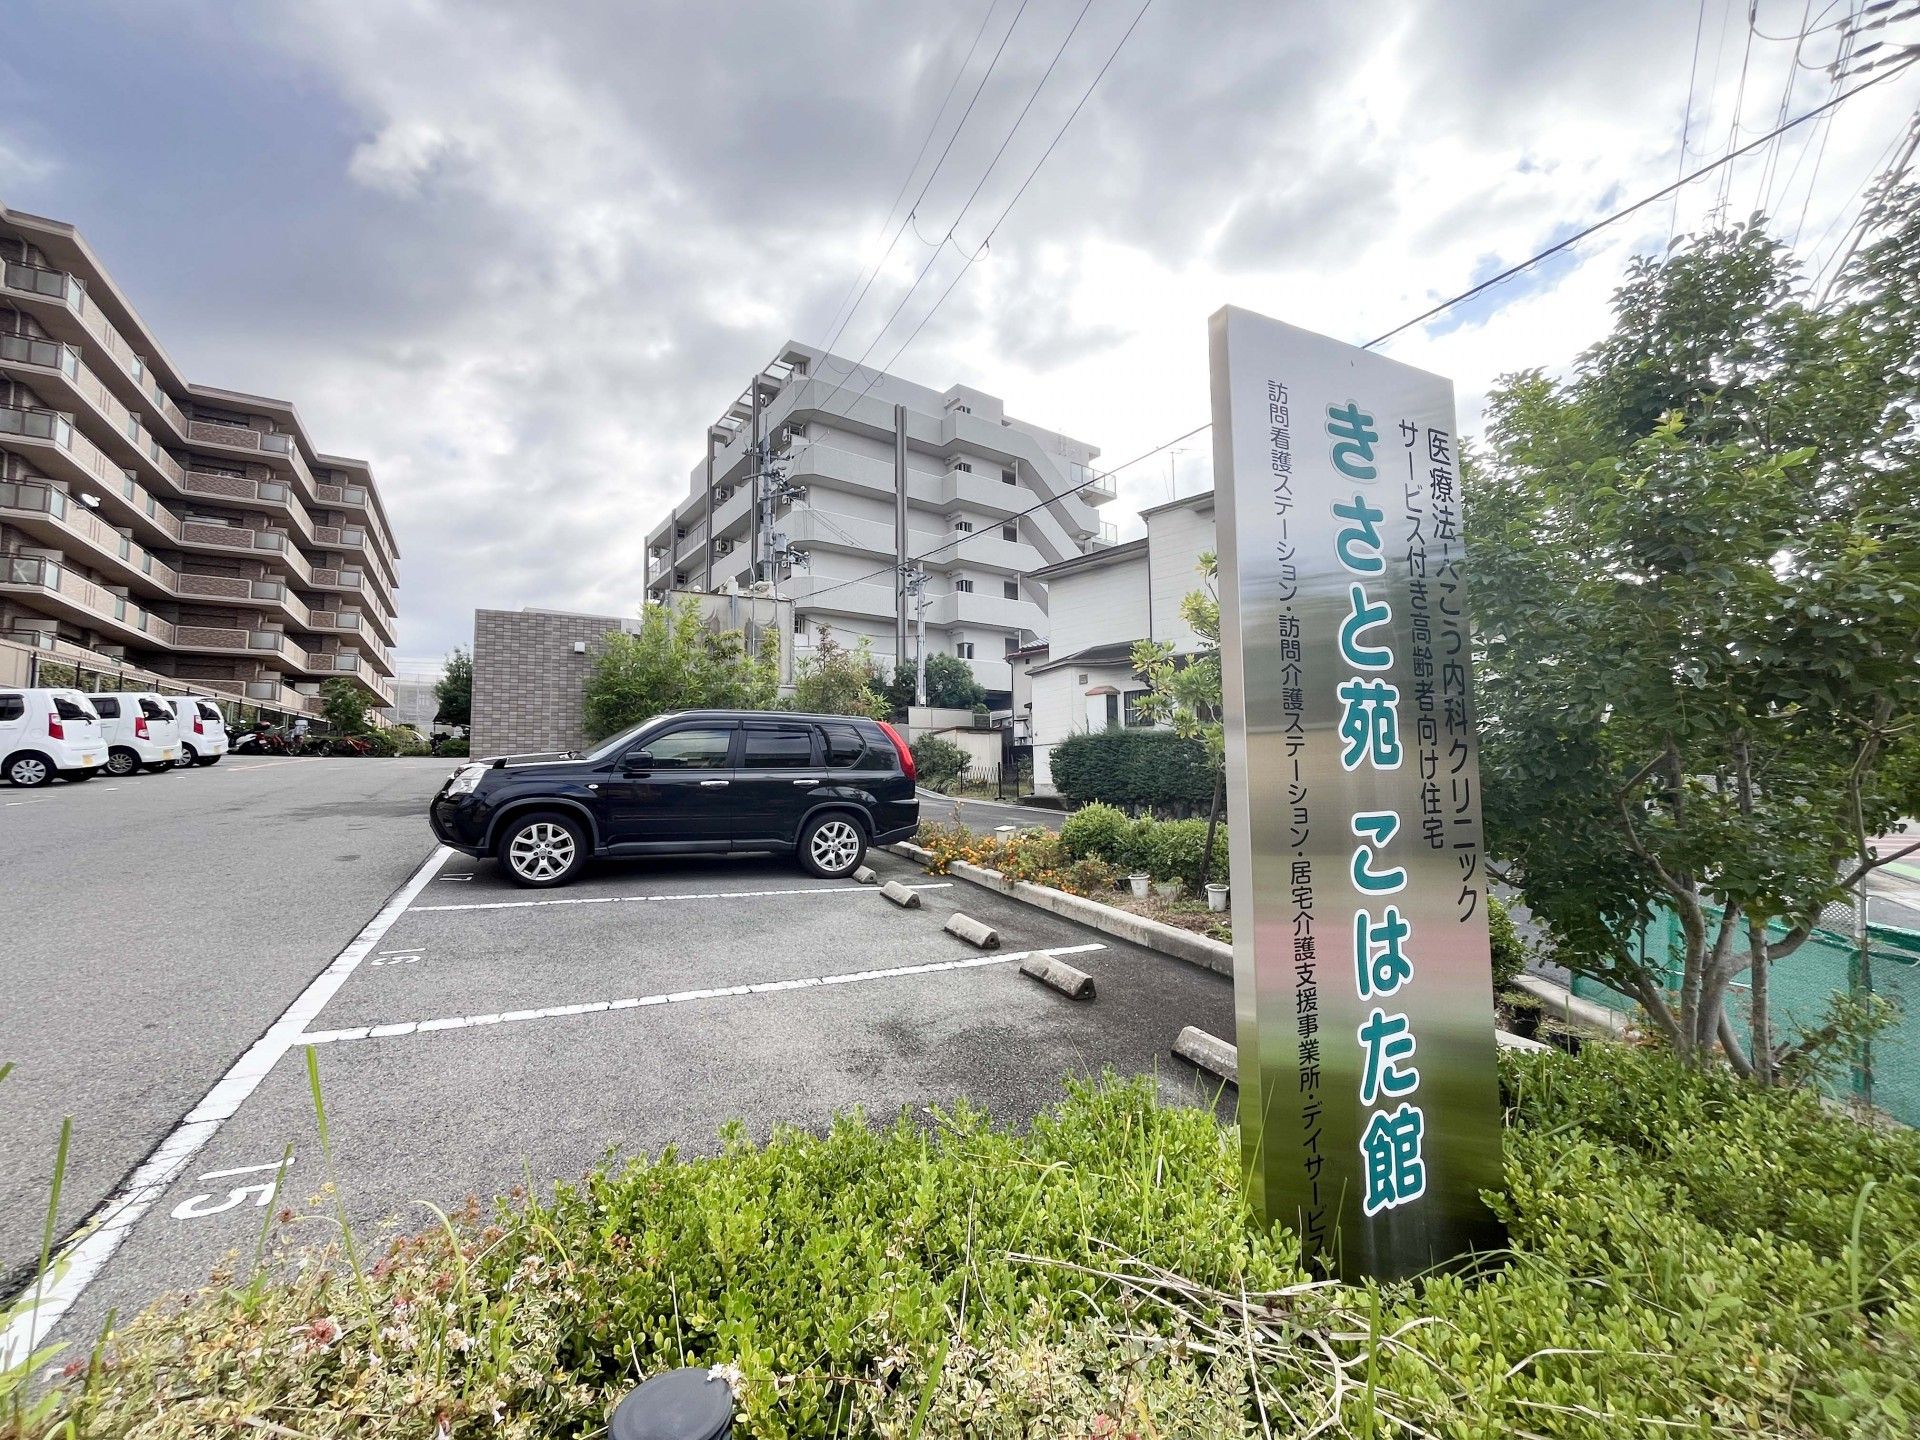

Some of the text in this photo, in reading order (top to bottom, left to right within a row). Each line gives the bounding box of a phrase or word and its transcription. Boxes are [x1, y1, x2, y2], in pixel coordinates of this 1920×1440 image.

[1325, 398, 1426, 1217] きさと苑 こはた館
[1399, 419, 1444, 849] サービス付き高齢者向け住宅
[171, 1157, 296, 1220] 15
